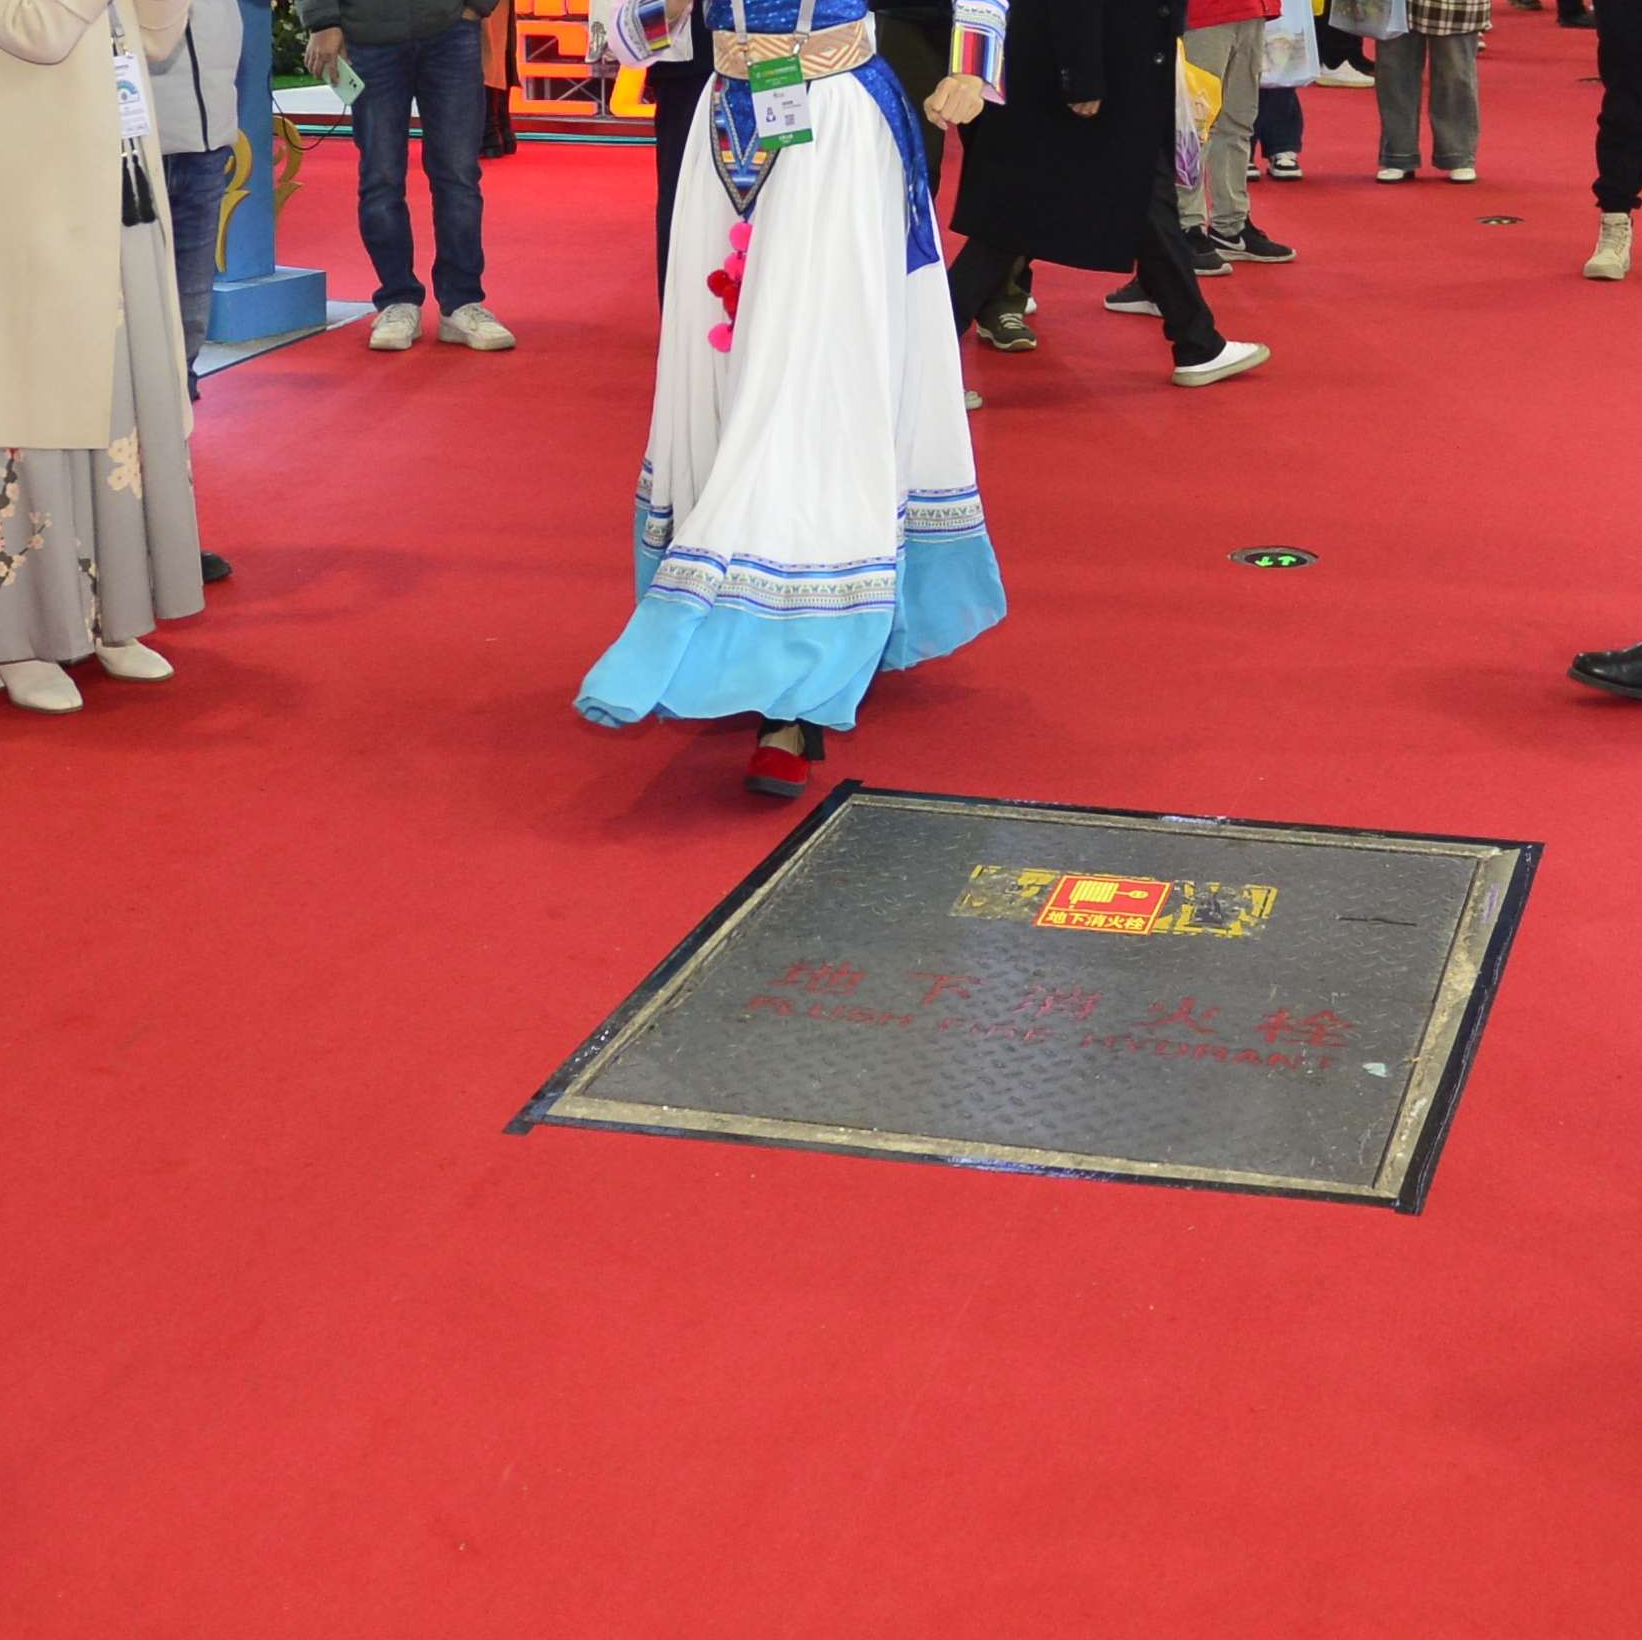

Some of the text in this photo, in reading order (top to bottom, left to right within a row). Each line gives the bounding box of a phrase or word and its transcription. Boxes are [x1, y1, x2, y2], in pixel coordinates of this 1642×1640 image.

[1046, 910, 1146, 930] 地下消火栓
[767, 959, 1353, 1049] 地下消火栓
[935, 1016, 1057, 1042] FIRE
